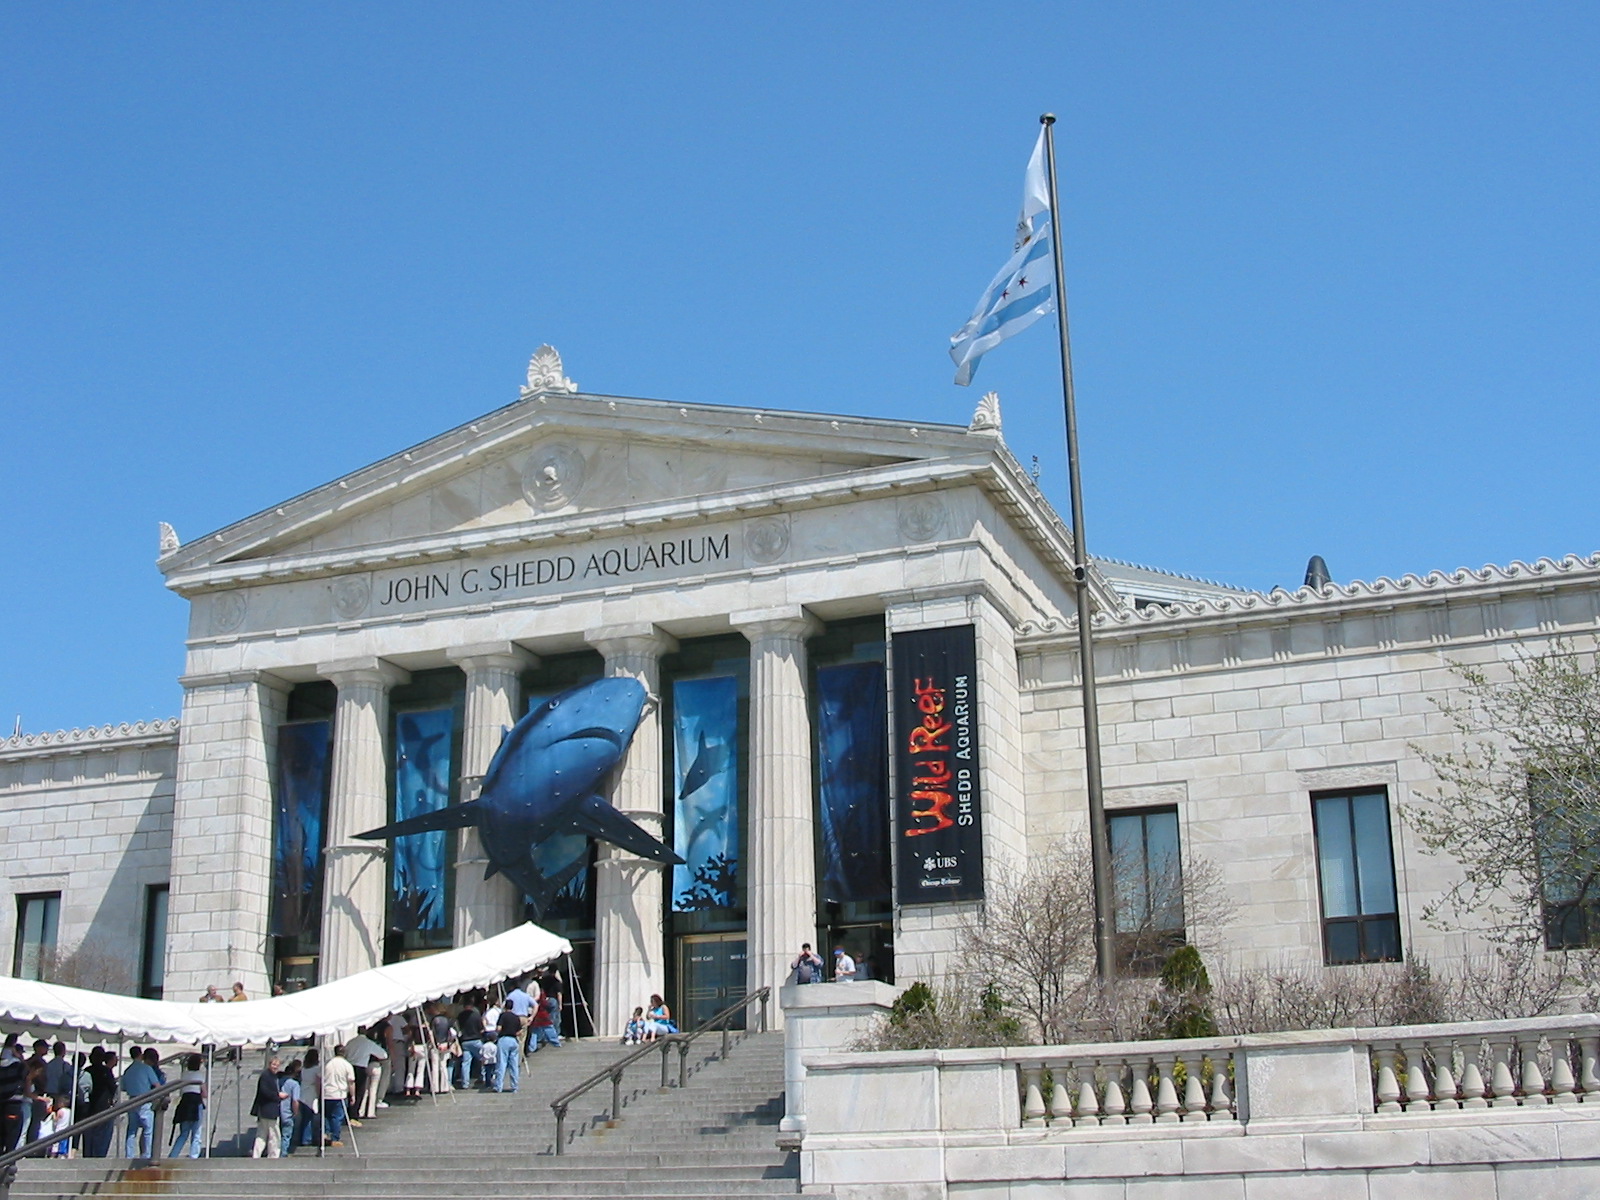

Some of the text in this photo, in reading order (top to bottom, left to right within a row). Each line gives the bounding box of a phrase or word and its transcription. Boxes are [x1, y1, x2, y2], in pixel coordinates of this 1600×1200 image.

[380, 533, 730, 606] JOHN G. SHEDD AQUARIUM
[954, 675, 974, 827] SHEDD AQUARIUM
[904, 760, 954, 837] Wild
[936, 856, 958, 869] UBS
